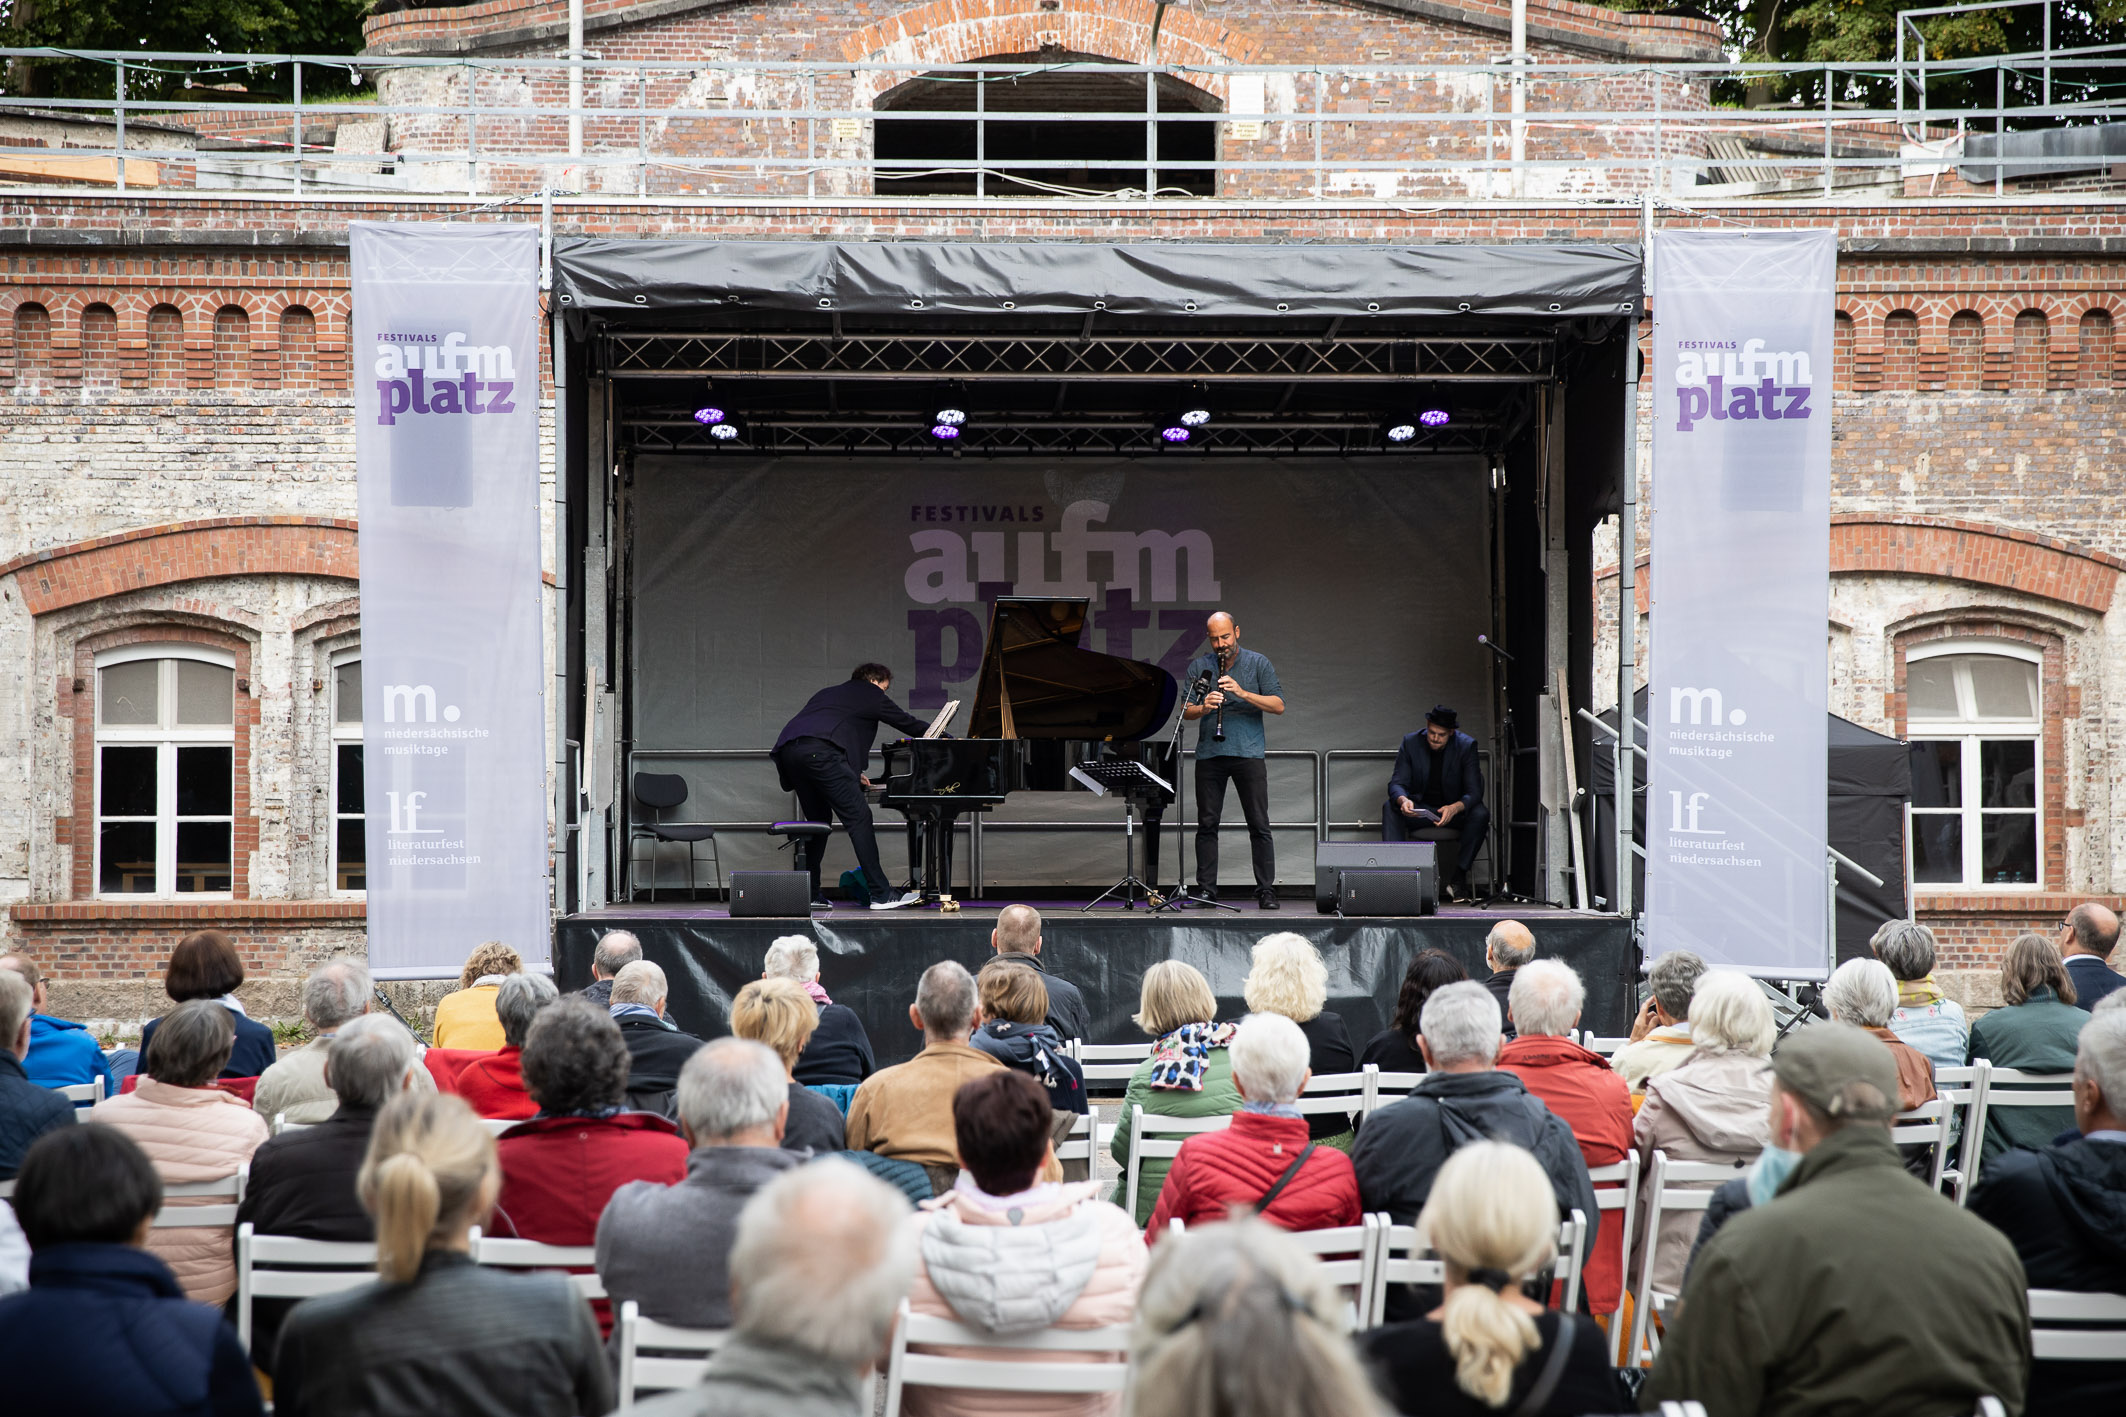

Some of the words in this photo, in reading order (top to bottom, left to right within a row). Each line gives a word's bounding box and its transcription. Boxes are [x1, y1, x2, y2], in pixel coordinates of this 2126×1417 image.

[377, 333, 437, 342] FESTIVALS
[1678, 341, 1737, 349] FESTIVALS
[375, 331, 516, 379] aufm
[1675, 338, 1813, 385] aufm
[377, 368, 516, 425] platz
[1676, 375, 1813, 432] platz
[911, 505, 1044, 523] FESTIVALS
[904, 500, 1221, 604] aufm
[383, 684, 461, 723] m.
[1670, 686, 1747, 726] m.
[384, 727, 489, 739] niedersächsische
[1669, 729, 1775, 743] niedersächsische
[384, 744, 449, 757] musiktage
[1669, 745, 1733, 760] musiktage
[387, 838, 465, 850] literaturfest
[1669, 836, 1745, 851] literaturfest
[388, 854, 481, 866] niedersachsen
[1669, 852, 1762, 867] niedersachsen
